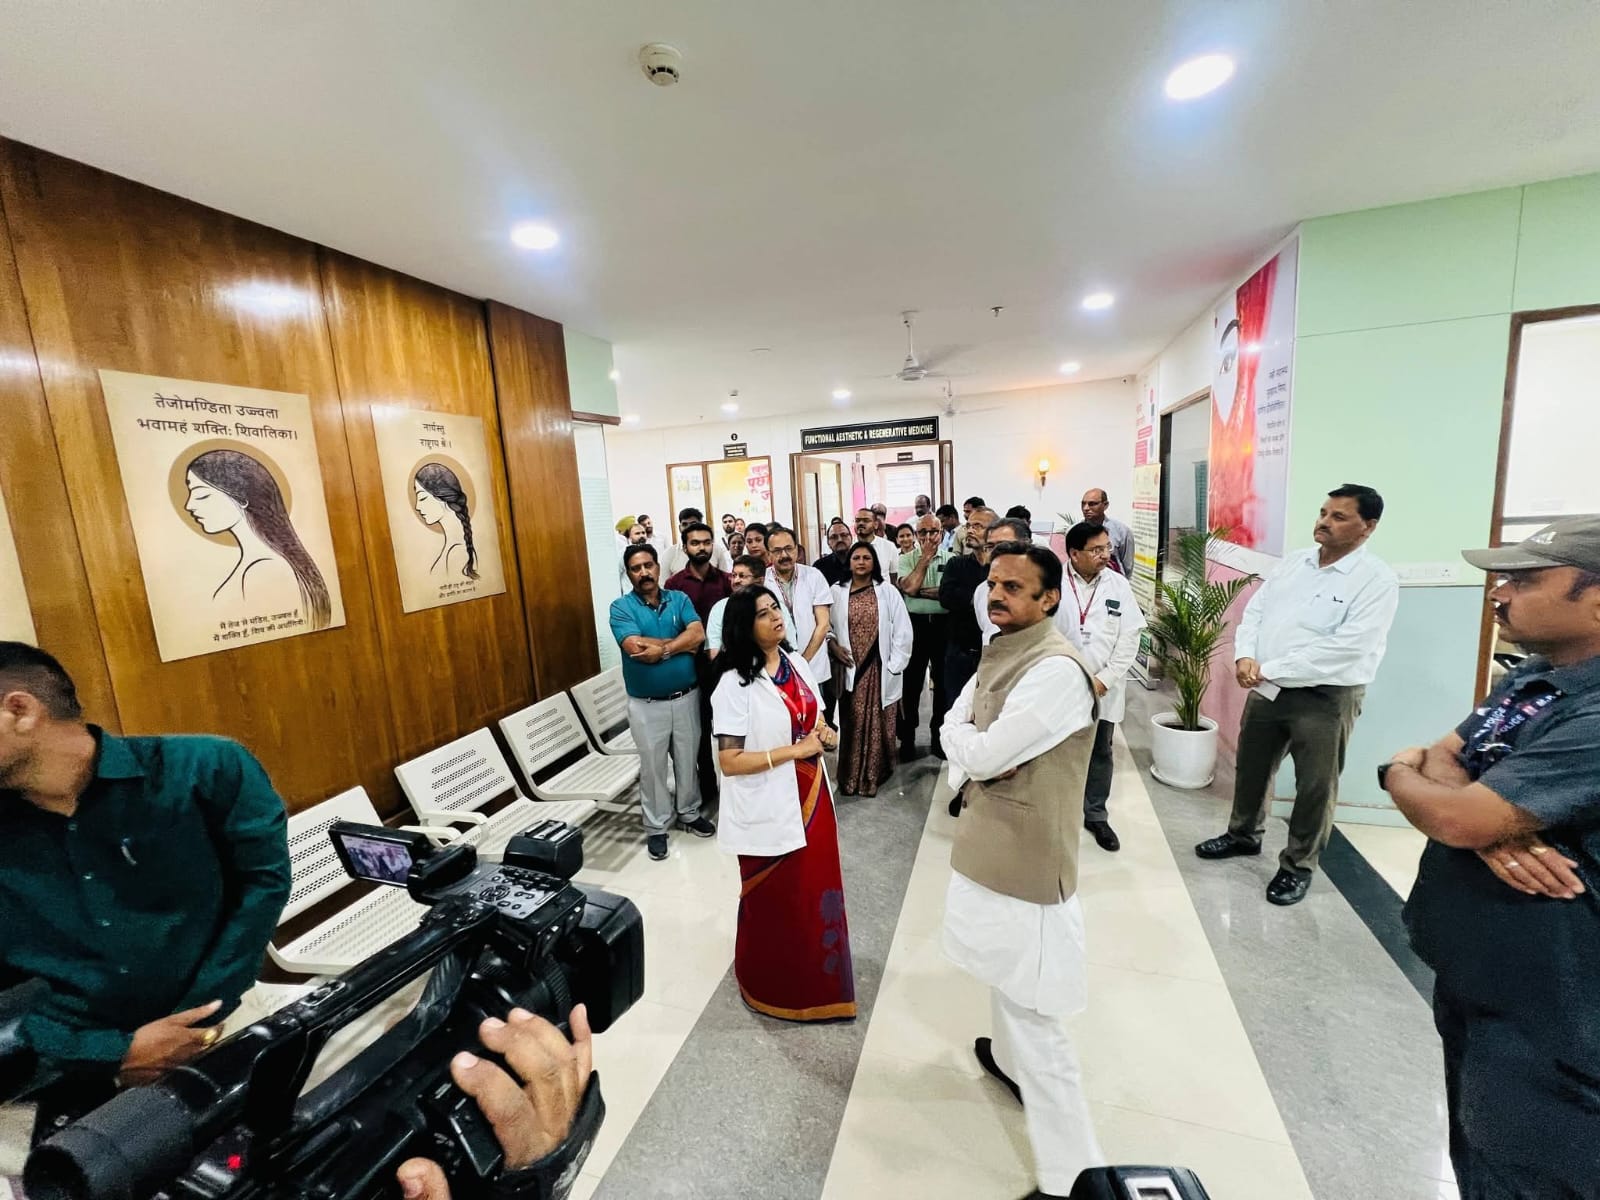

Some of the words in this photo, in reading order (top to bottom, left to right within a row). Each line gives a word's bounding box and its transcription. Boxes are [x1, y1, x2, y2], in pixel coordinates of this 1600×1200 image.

[153, 393, 232, 415] तेजोमण्डिता
[136, 418, 188, 435] भवामहं
[804, 433, 836, 445] FUNCTIONAL
[835, 430, 863, 442] AESTHETIC
[863, 430, 868, 440] &
[869, 426, 907, 439] REGENERATIVE
[908, 424, 934, 436] MEDICINE
[1483, 706, 1506, 728] POLICE
